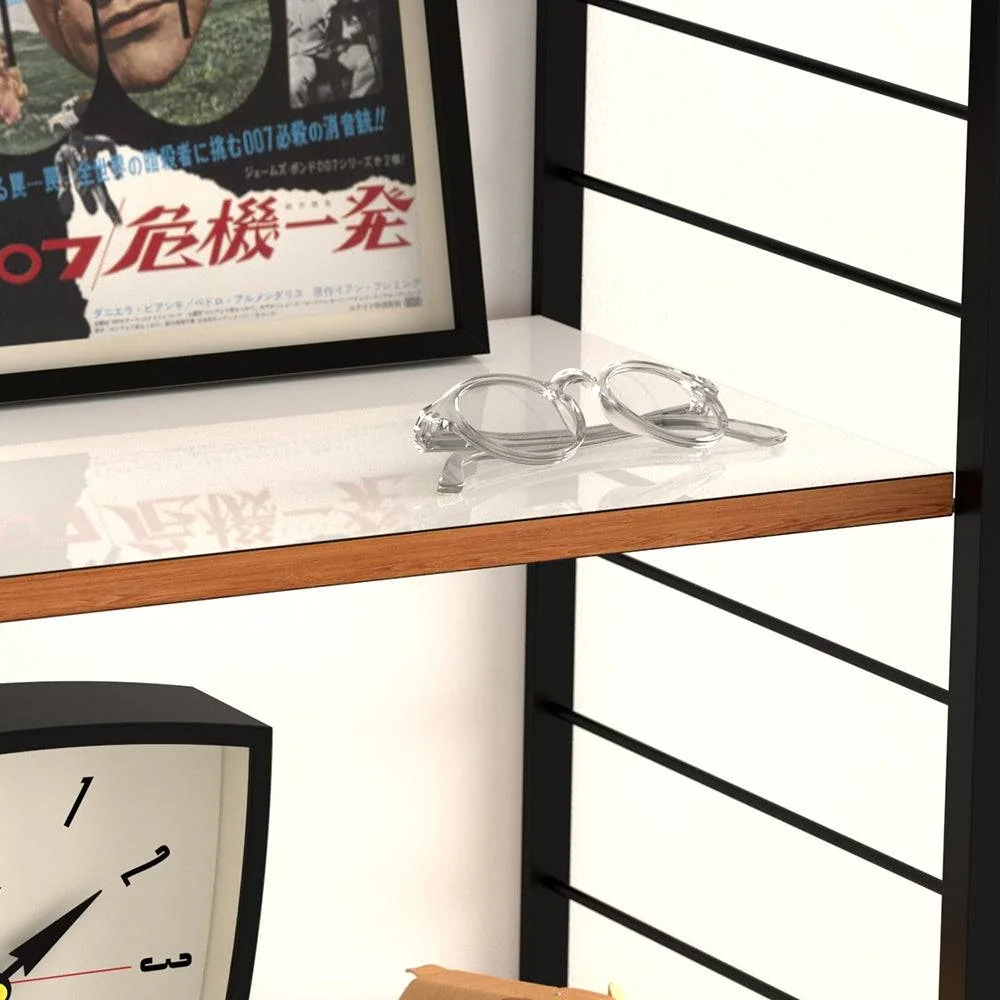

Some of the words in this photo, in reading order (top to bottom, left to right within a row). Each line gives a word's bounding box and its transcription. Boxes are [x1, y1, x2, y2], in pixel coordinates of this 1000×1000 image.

[100, 184, 415, 277] 危機一発
[63, 776, 95, 828] 1
[120, 845, 171, 888] 2
[139, 952, 193, 973] 3
